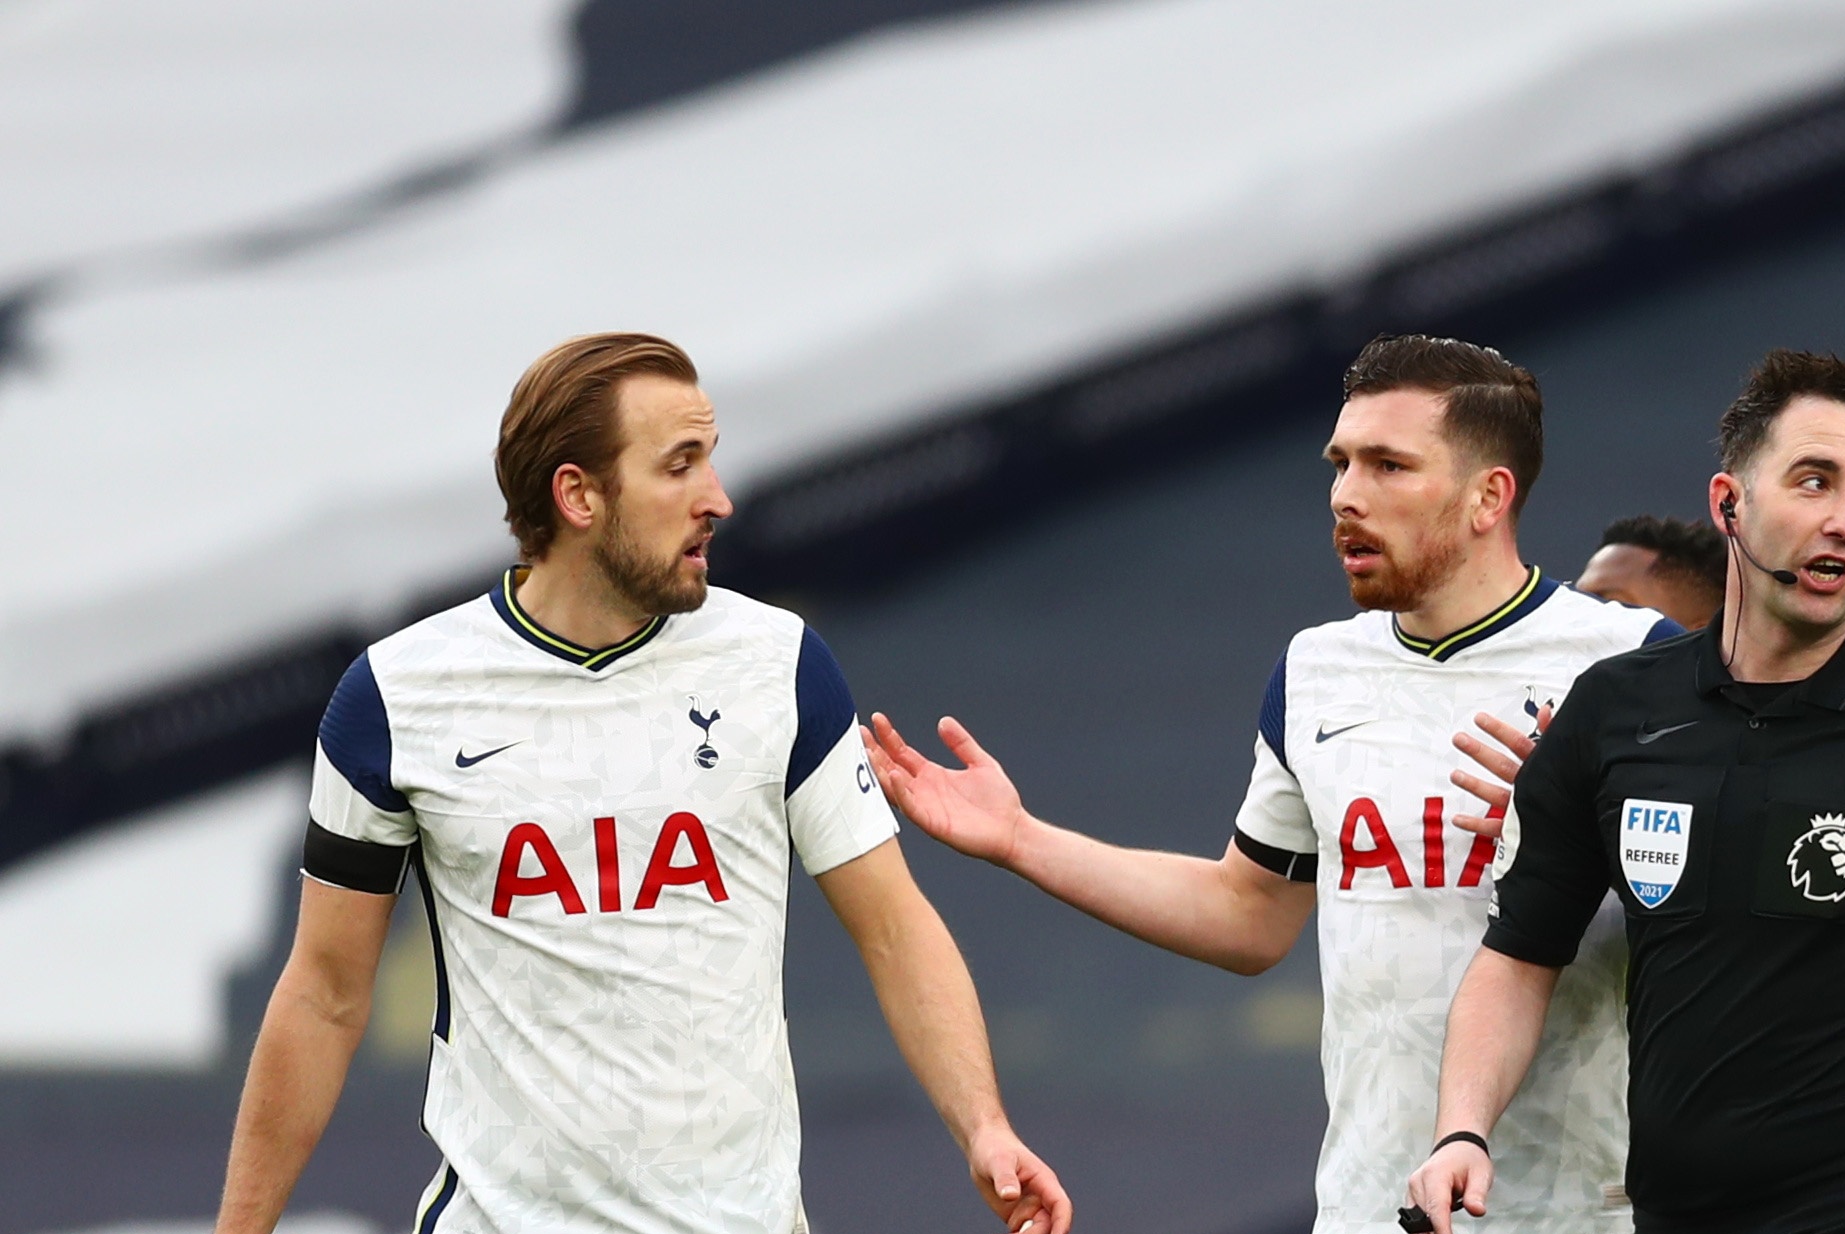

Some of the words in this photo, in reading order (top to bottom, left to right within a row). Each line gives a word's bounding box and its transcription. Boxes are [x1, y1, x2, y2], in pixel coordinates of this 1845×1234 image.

[1627, 806, 1682, 835] FIFA
[492, 811, 729, 918] AIA
[1625, 848, 1680, 866] REFEREE
[1639, 884, 1662, 898] 2021
